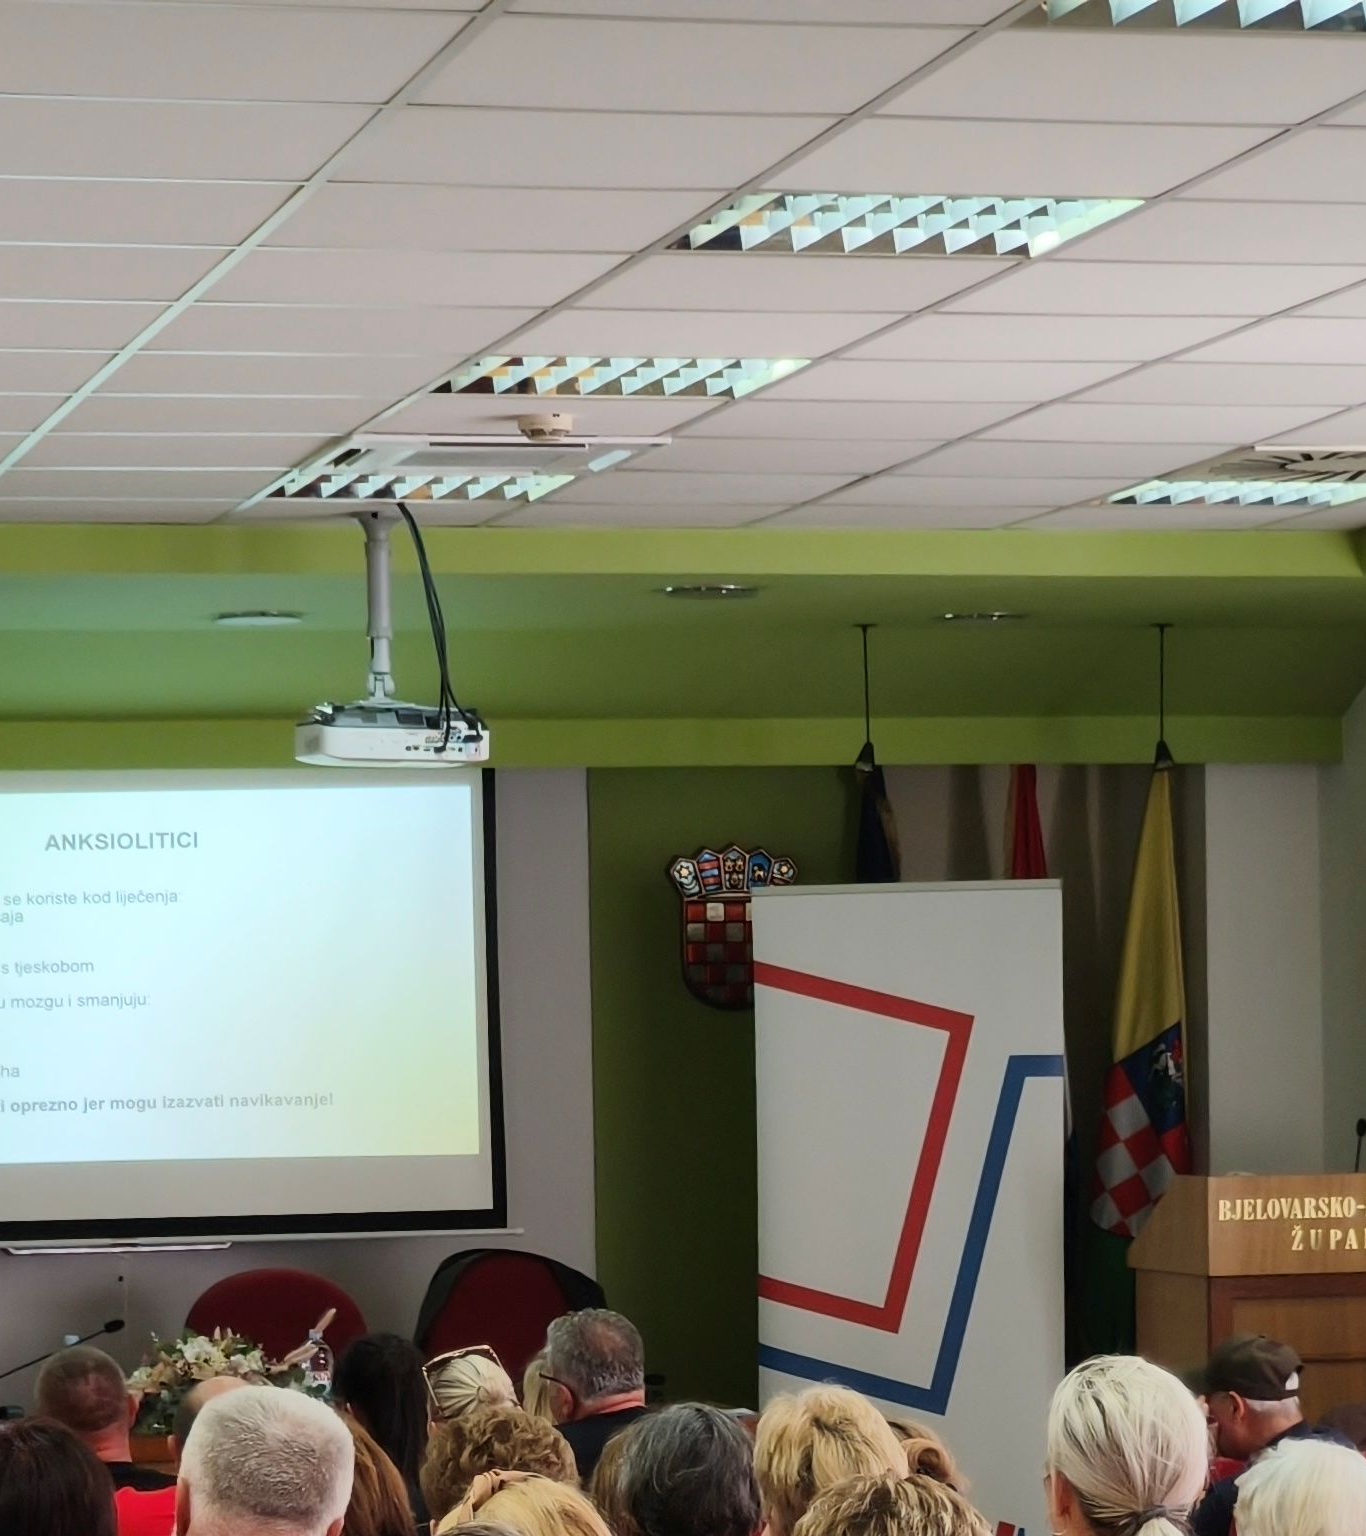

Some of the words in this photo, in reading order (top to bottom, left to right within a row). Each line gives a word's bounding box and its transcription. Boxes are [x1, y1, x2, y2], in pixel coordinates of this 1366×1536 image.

[44, 831, 198, 851] ANKSIOLITICI
[3, 895, 21, 906] se
[26, 891, 77, 906] koriste
[83, 890, 111, 904] kod
[1, 964, 10, 976] s
[14, 959, 94, 977] tjeskobom
[11, 997, 63, 1012] mozgu
[10, 1099, 78, 1116] oprezno
[83, 1096, 105, 1114] jer
[110, 1098, 157, 1112] mogu
[162, 1093, 225, 1109] izazvati
[229, 1092, 334, 1110] navikavanje!
